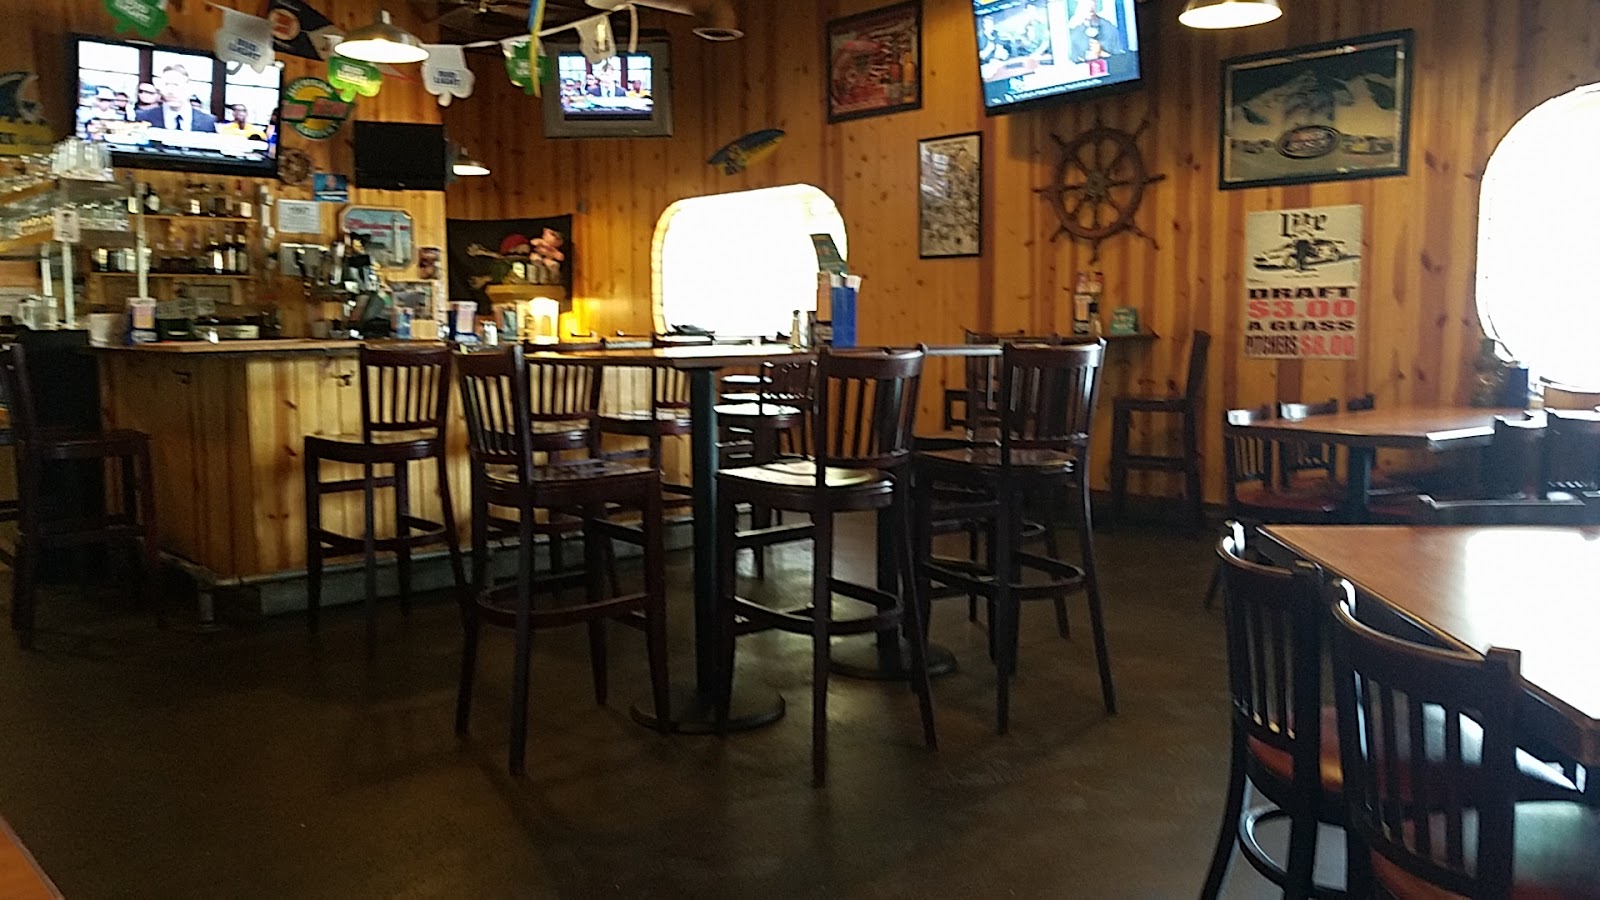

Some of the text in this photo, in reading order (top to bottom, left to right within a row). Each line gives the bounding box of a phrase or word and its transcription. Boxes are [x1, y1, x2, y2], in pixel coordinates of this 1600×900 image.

[1249, 286, 1355, 298] DRAFT
[1247, 300, 1355, 319] $3.00
[1247, 320, 1355, 331] A GLASS
[1246, 334, 1355, 355] PITCHERS $8.00
